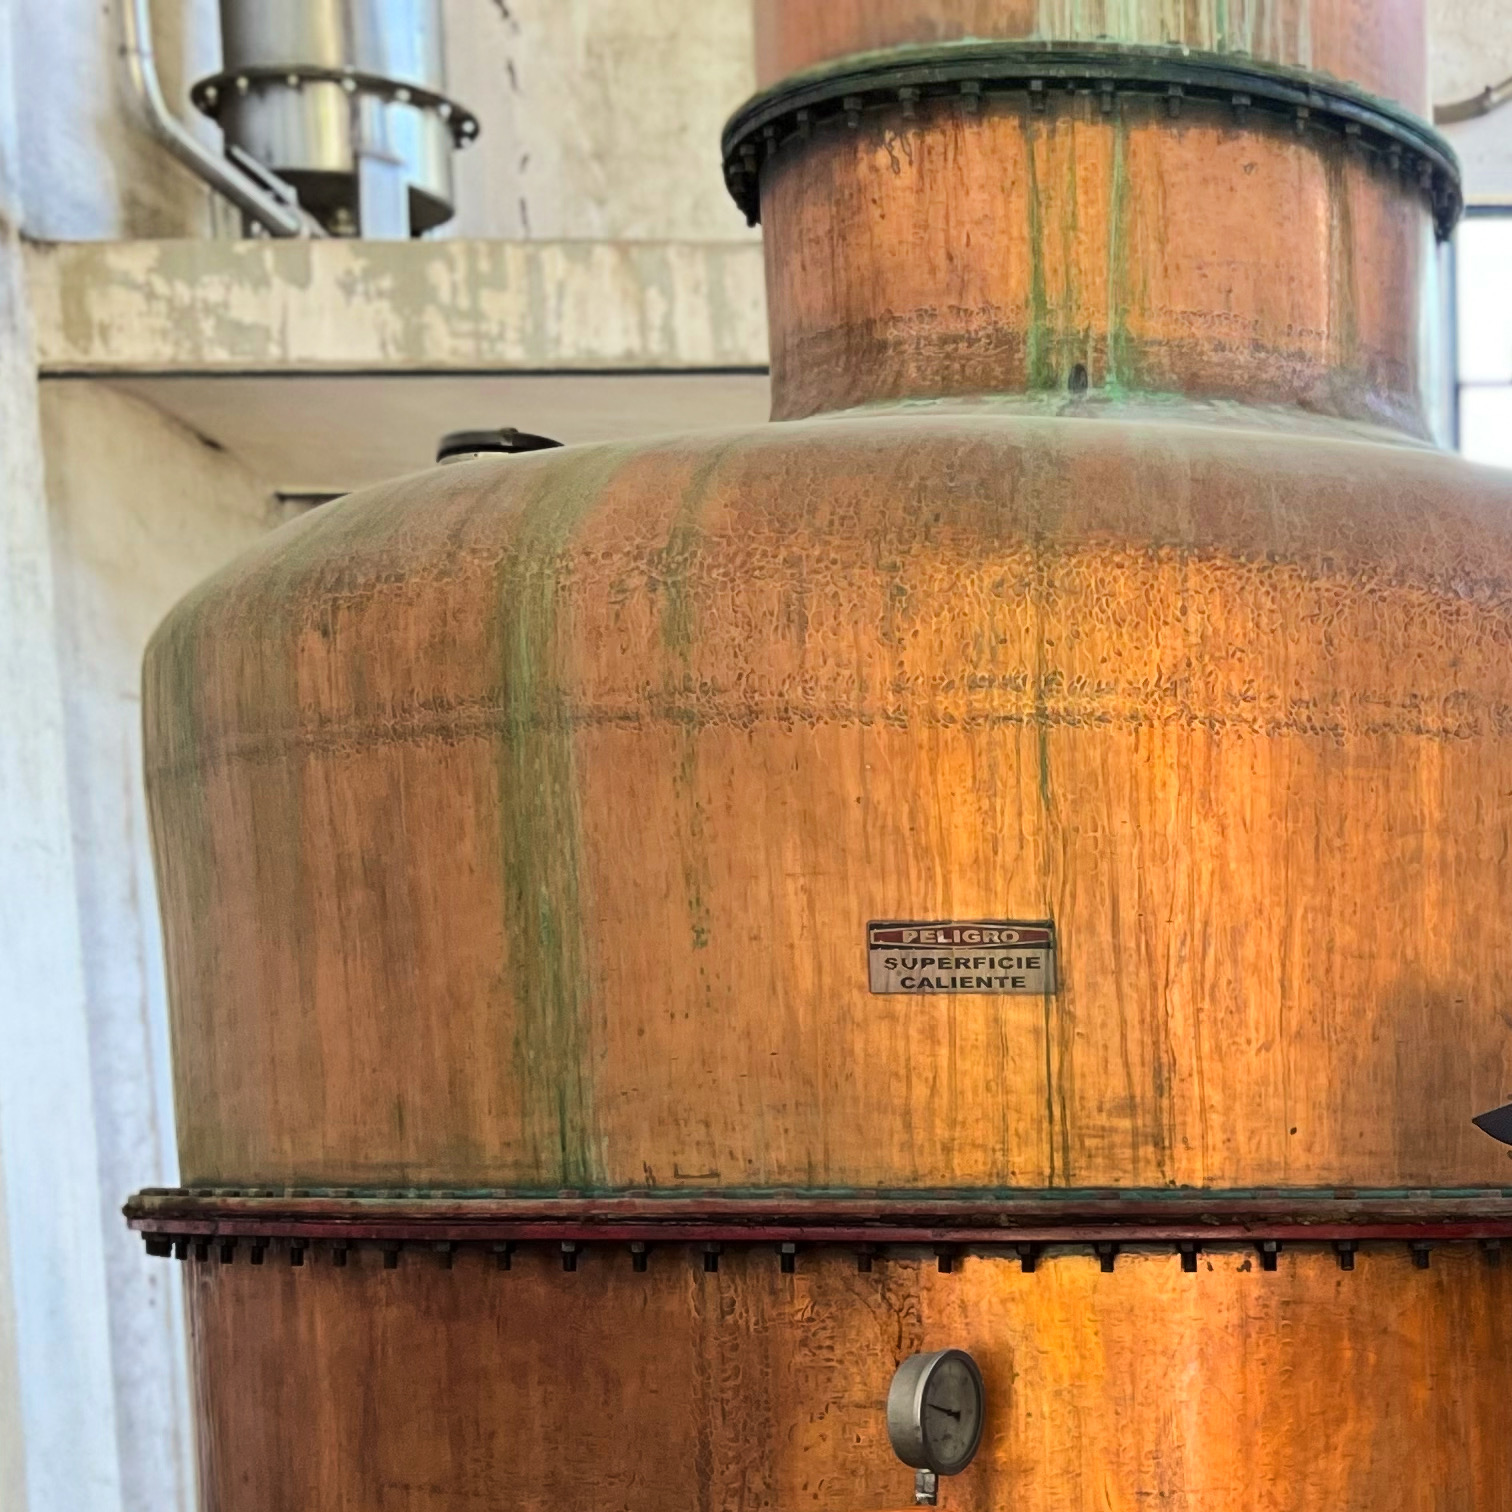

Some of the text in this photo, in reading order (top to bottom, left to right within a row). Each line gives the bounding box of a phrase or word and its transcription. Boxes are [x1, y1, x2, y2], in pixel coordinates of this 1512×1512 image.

[902, 929, 1020, 944] PELIGRO
[883, 956, 1041, 970] SUPERFICIE
[900, 976, 1026, 989] CALIENTE
